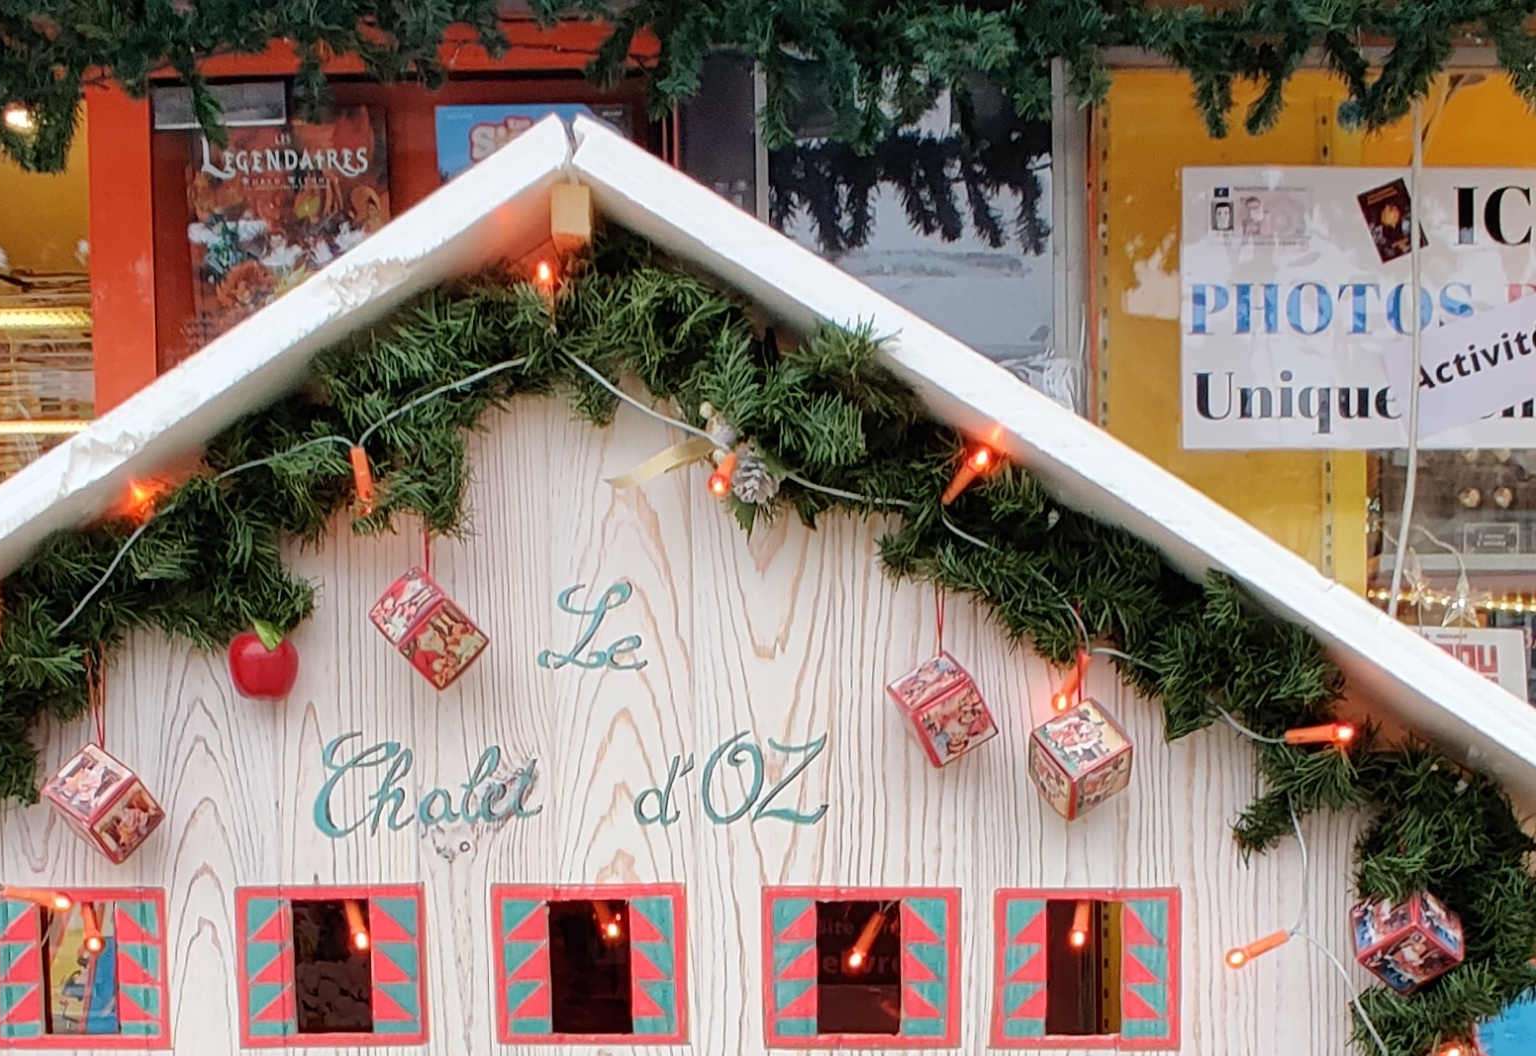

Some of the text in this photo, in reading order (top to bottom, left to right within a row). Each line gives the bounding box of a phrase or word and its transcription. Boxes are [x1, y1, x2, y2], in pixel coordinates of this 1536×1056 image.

[273, 133, 292, 147] LES
[1188, 282, 1474, 336] PHOTOS
[537, 581, 649, 671] Le
[313, 729, 830, 839] Chalet d'OZ
